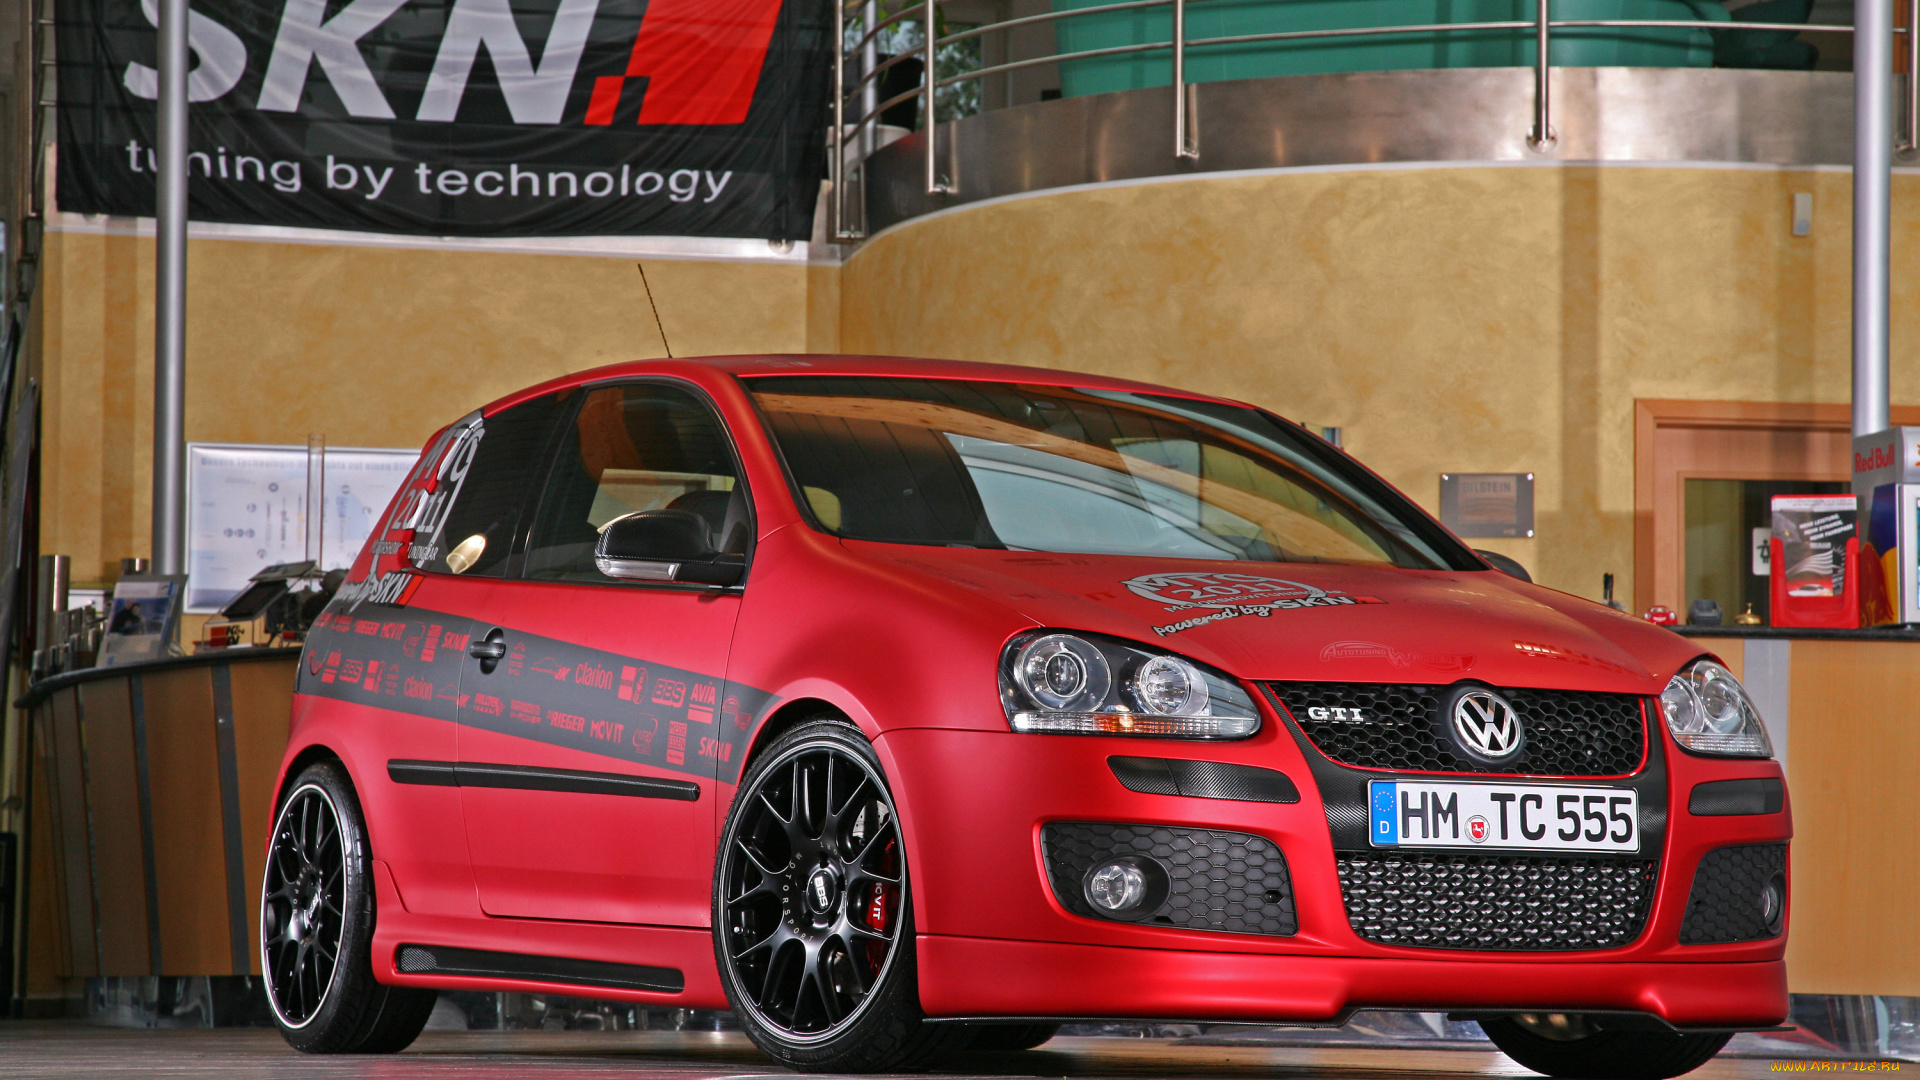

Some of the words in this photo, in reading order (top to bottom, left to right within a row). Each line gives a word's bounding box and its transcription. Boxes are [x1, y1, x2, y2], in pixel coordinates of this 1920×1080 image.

[126, 140, 301, 193] tning
[327, 155, 394, 200] by
[415, 162, 733, 203] technology
[1855, 448, 1874, 473] Red
[1876, 444, 1895, 468] Bull
[391, 488, 447, 533] 2011
[368, 572, 412, 604] SKN
[1140, 573, 1265, 591] MTC
[1171, 580, 1295, 599] 2011
[1154, 609, 1239, 637] powered
[1240, 605, 1271, 616] by
[1274, 596, 1357, 609] SKN
[404, 675, 433, 700] clarion
[575, 662, 613, 690] clarion
[651, 678, 687, 708] BBS
[690, 681, 716, 705] AVIA
[1308, 707, 1363, 721] GTI
[1379, 819, 1390, 834] D
[1401, 791, 1459, 839] HM
[1490, 793, 1546, 841] TC
[1556, 795, 1633, 843] 555
[813, 876, 829, 910] BBS
